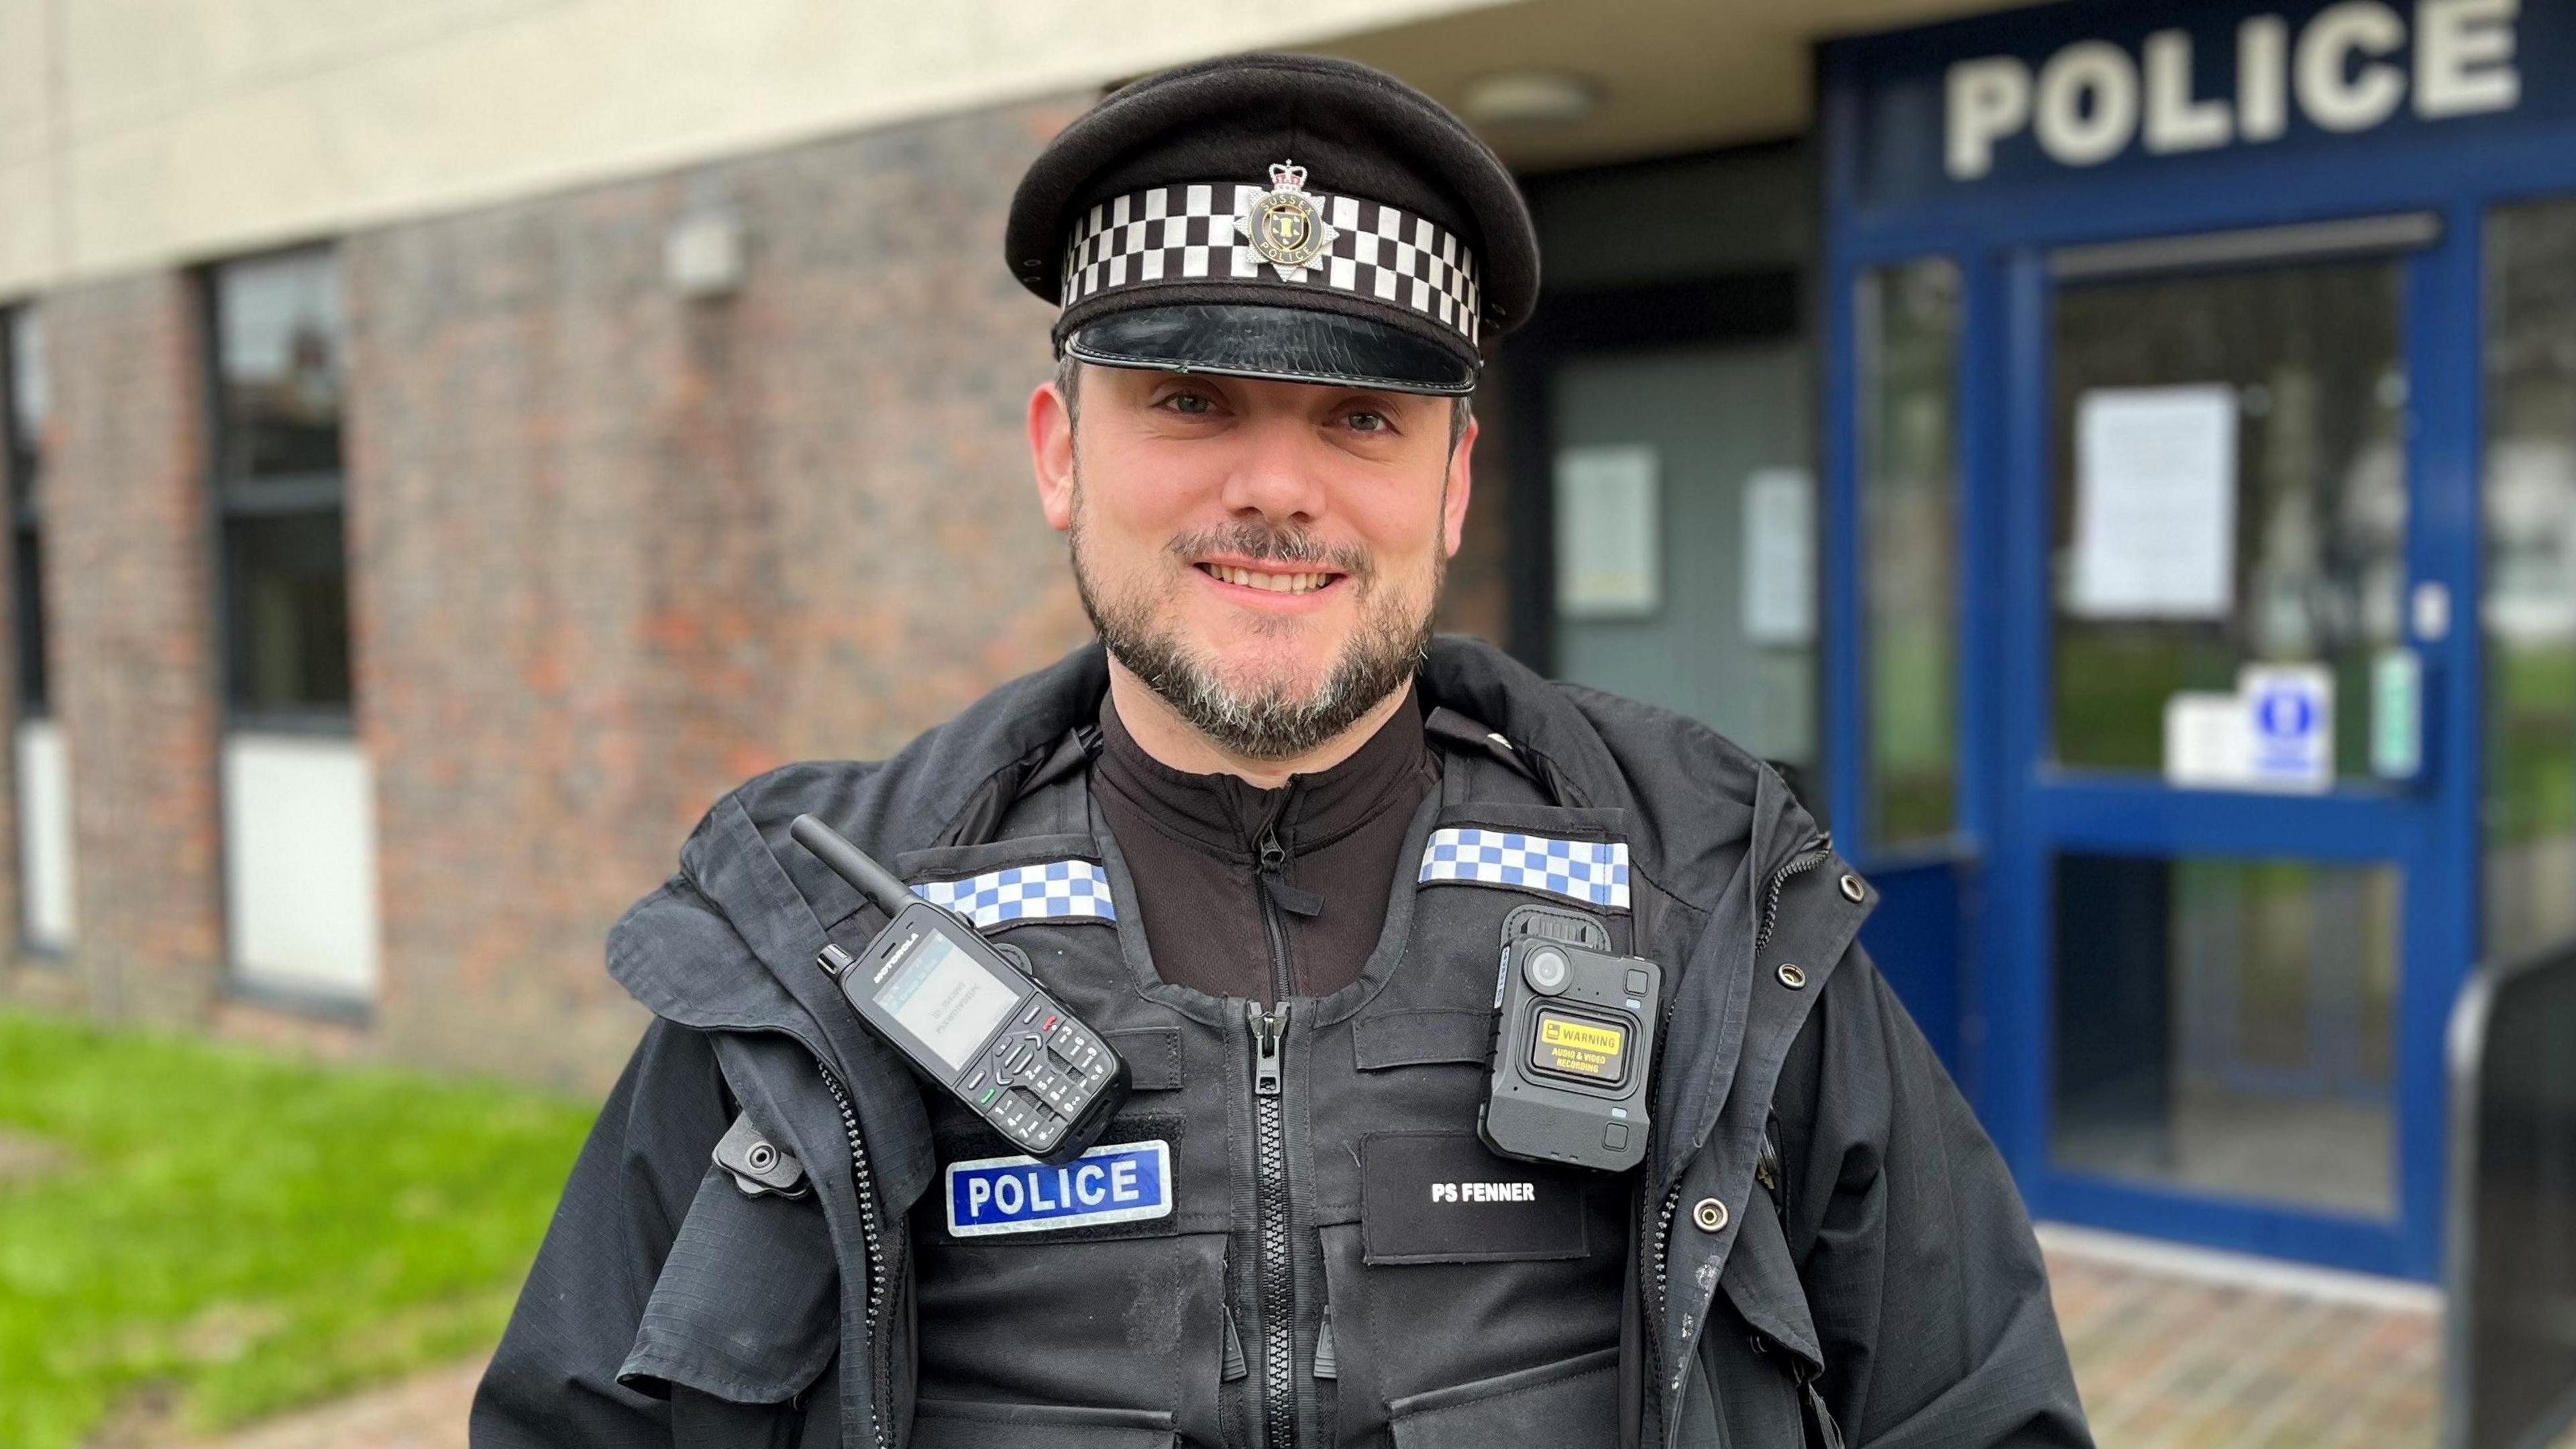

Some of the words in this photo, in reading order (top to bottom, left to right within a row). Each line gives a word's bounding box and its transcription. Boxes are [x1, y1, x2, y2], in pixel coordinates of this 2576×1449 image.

[1943, 0, 2521, 181] POLICE
[1260, 195, 1314, 215] SUSSEX
[1260, 242, 1312, 262] POLICE
[874, 933, 919, 983] MOTOROLA
[1062, 1026, 1072, 1036] 3
[1075, 1036, 1085, 1046] 6
[1563, 1029, 1615, 1048] WARNING
[1087, 1046, 1097, 1057] 9
[1552, 1047, 1575, 1059] AUDIO
[1576, 1052, 1582, 1060] &
[1584, 1053, 1606, 1064] VIDEO
[1556, 1059, 1599, 1073] RECORDING
[1025, 1070, 1035, 1080] 2
[1037, 1080, 1047, 1090] 5
[1050, 1091, 1061, 1101] 8
[995, 1106, 1005, 1115] 1
[1064, 1102, 1074, 1112] 0
[1007, 1118, 1017, 1126] 4
[1019, 1128, 1028, 1138] 7
[969, 1160, 1139, 1218] POLICE
[1432, 1183, 1458, 1203] PS
[1461, 1183, 1536, 1202] FENNER
